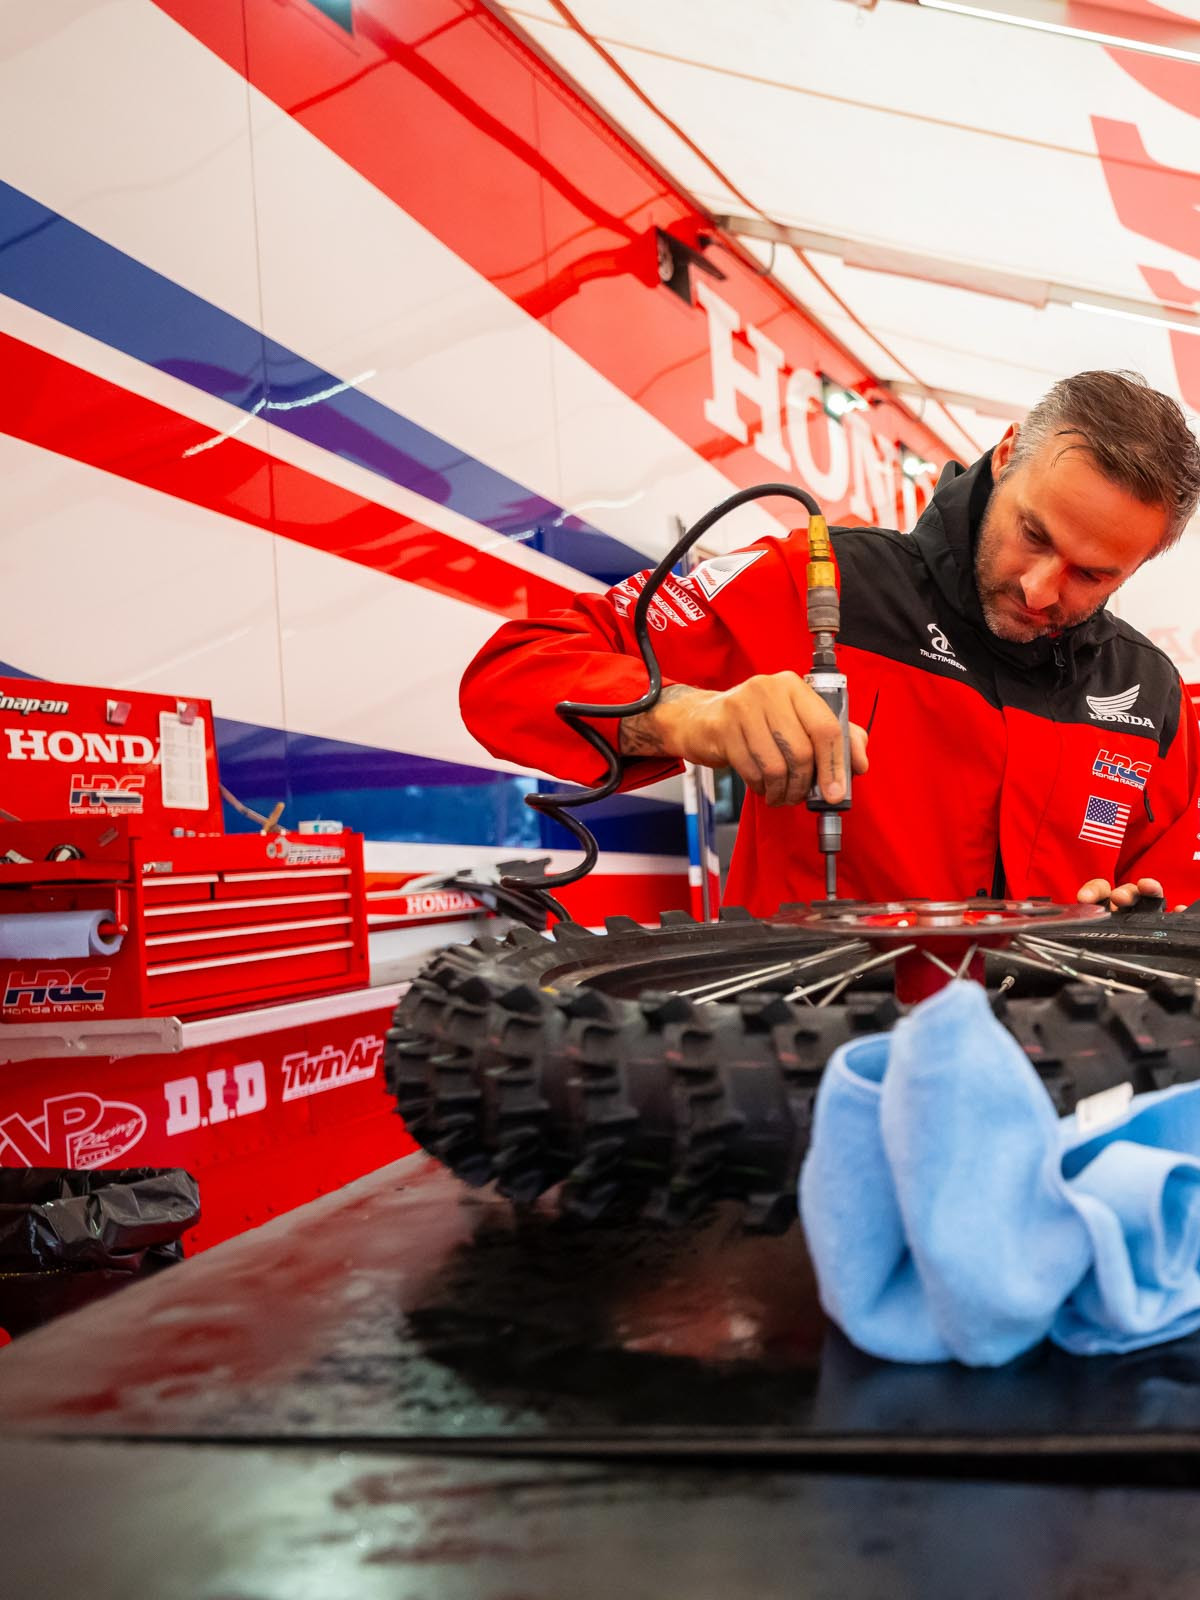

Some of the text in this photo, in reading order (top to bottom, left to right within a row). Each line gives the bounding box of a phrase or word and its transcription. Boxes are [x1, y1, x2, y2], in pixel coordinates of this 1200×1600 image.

[919, 648, 967, 671] TRUETIMBER
[0, 691, 69, 715] nap-on
[1088, 712, 1155, 729] HONDA
[1092, 771, 1119, 782] Honda
[1093, 749, 1152, 786] HRC
[69, 774, 145, 807] HRC
[406, 889, 475, 914] HONDA
[3, 966, 111, 1007] HRC
[3, 1003, 105, 1015] Honda RACING
